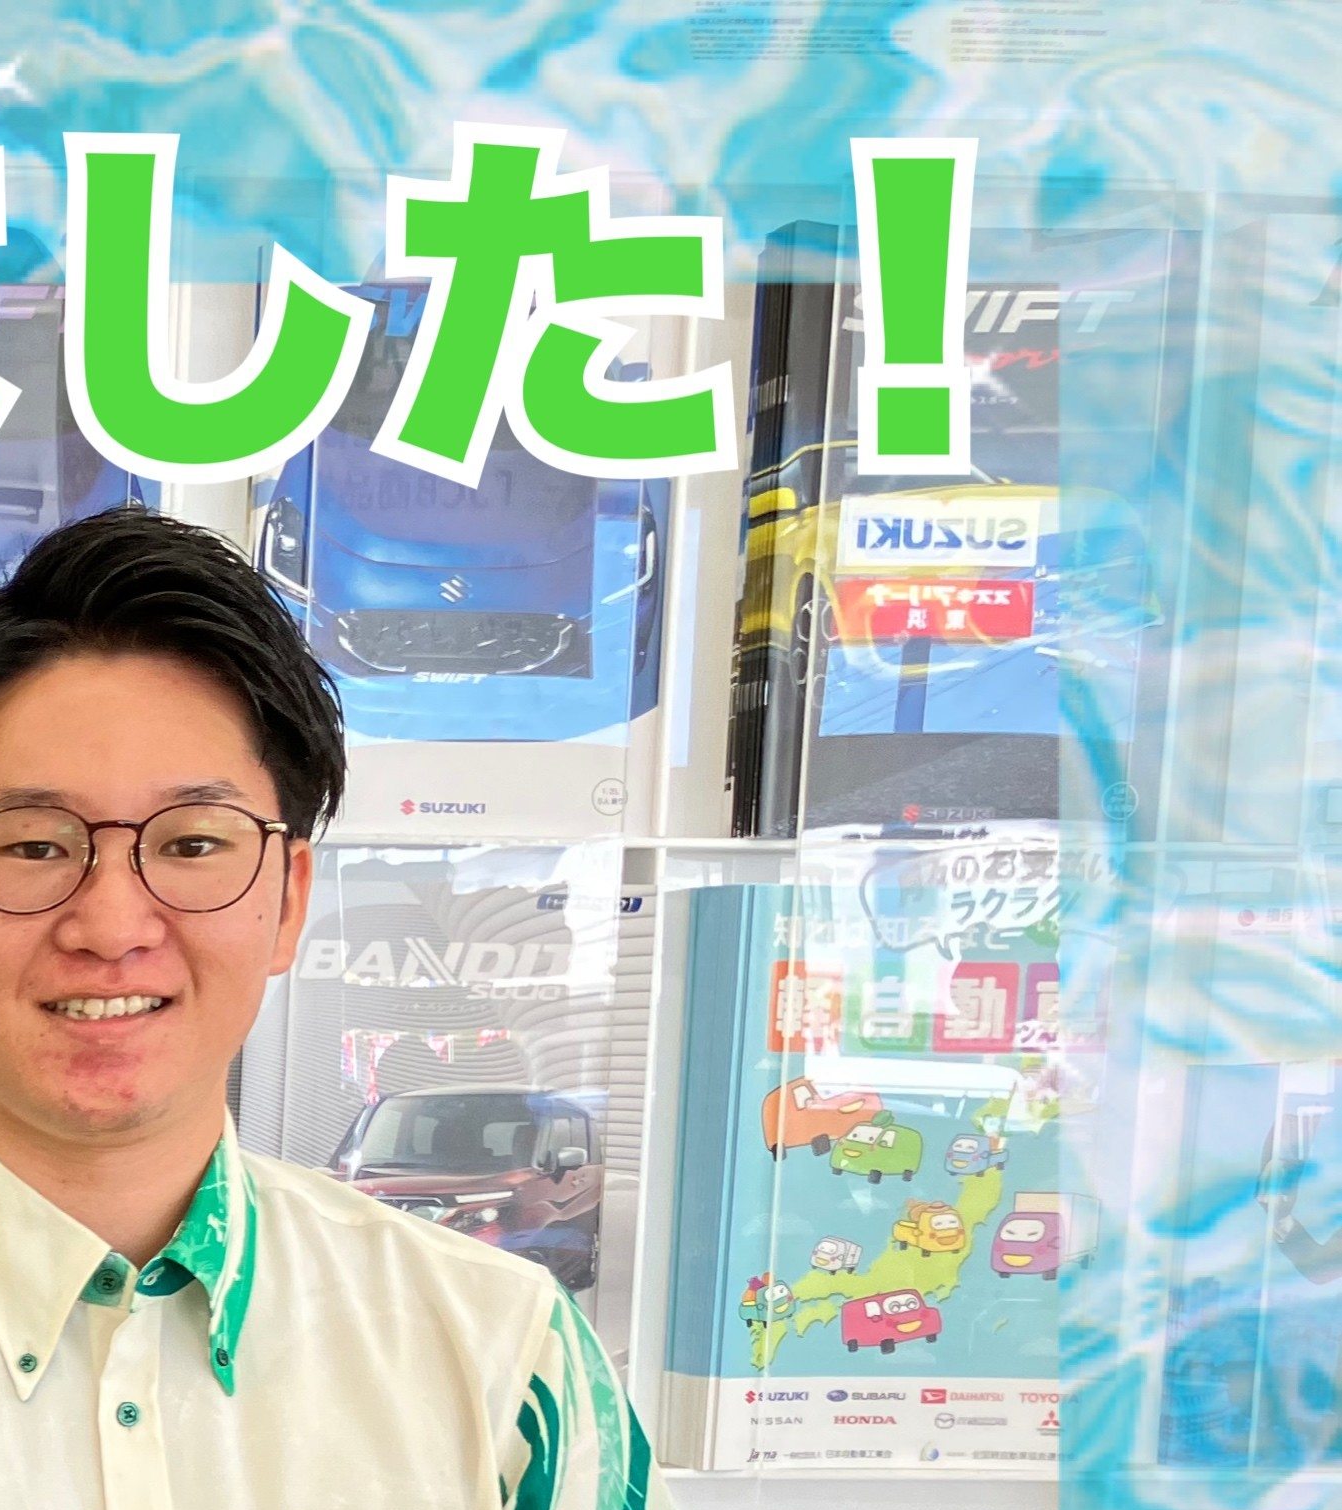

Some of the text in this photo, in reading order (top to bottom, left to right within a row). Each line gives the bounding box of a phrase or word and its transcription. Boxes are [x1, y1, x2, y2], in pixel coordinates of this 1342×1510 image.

[412, 671, 489, 685] SWIFT
[419, 802, 486, 815] SUZUKI
[851, 1391, 907, 1402] SUBARU
[949, 1391, 1005, 1403] DAIHATSU
[833, 1414, 898, 1426] HONDA
